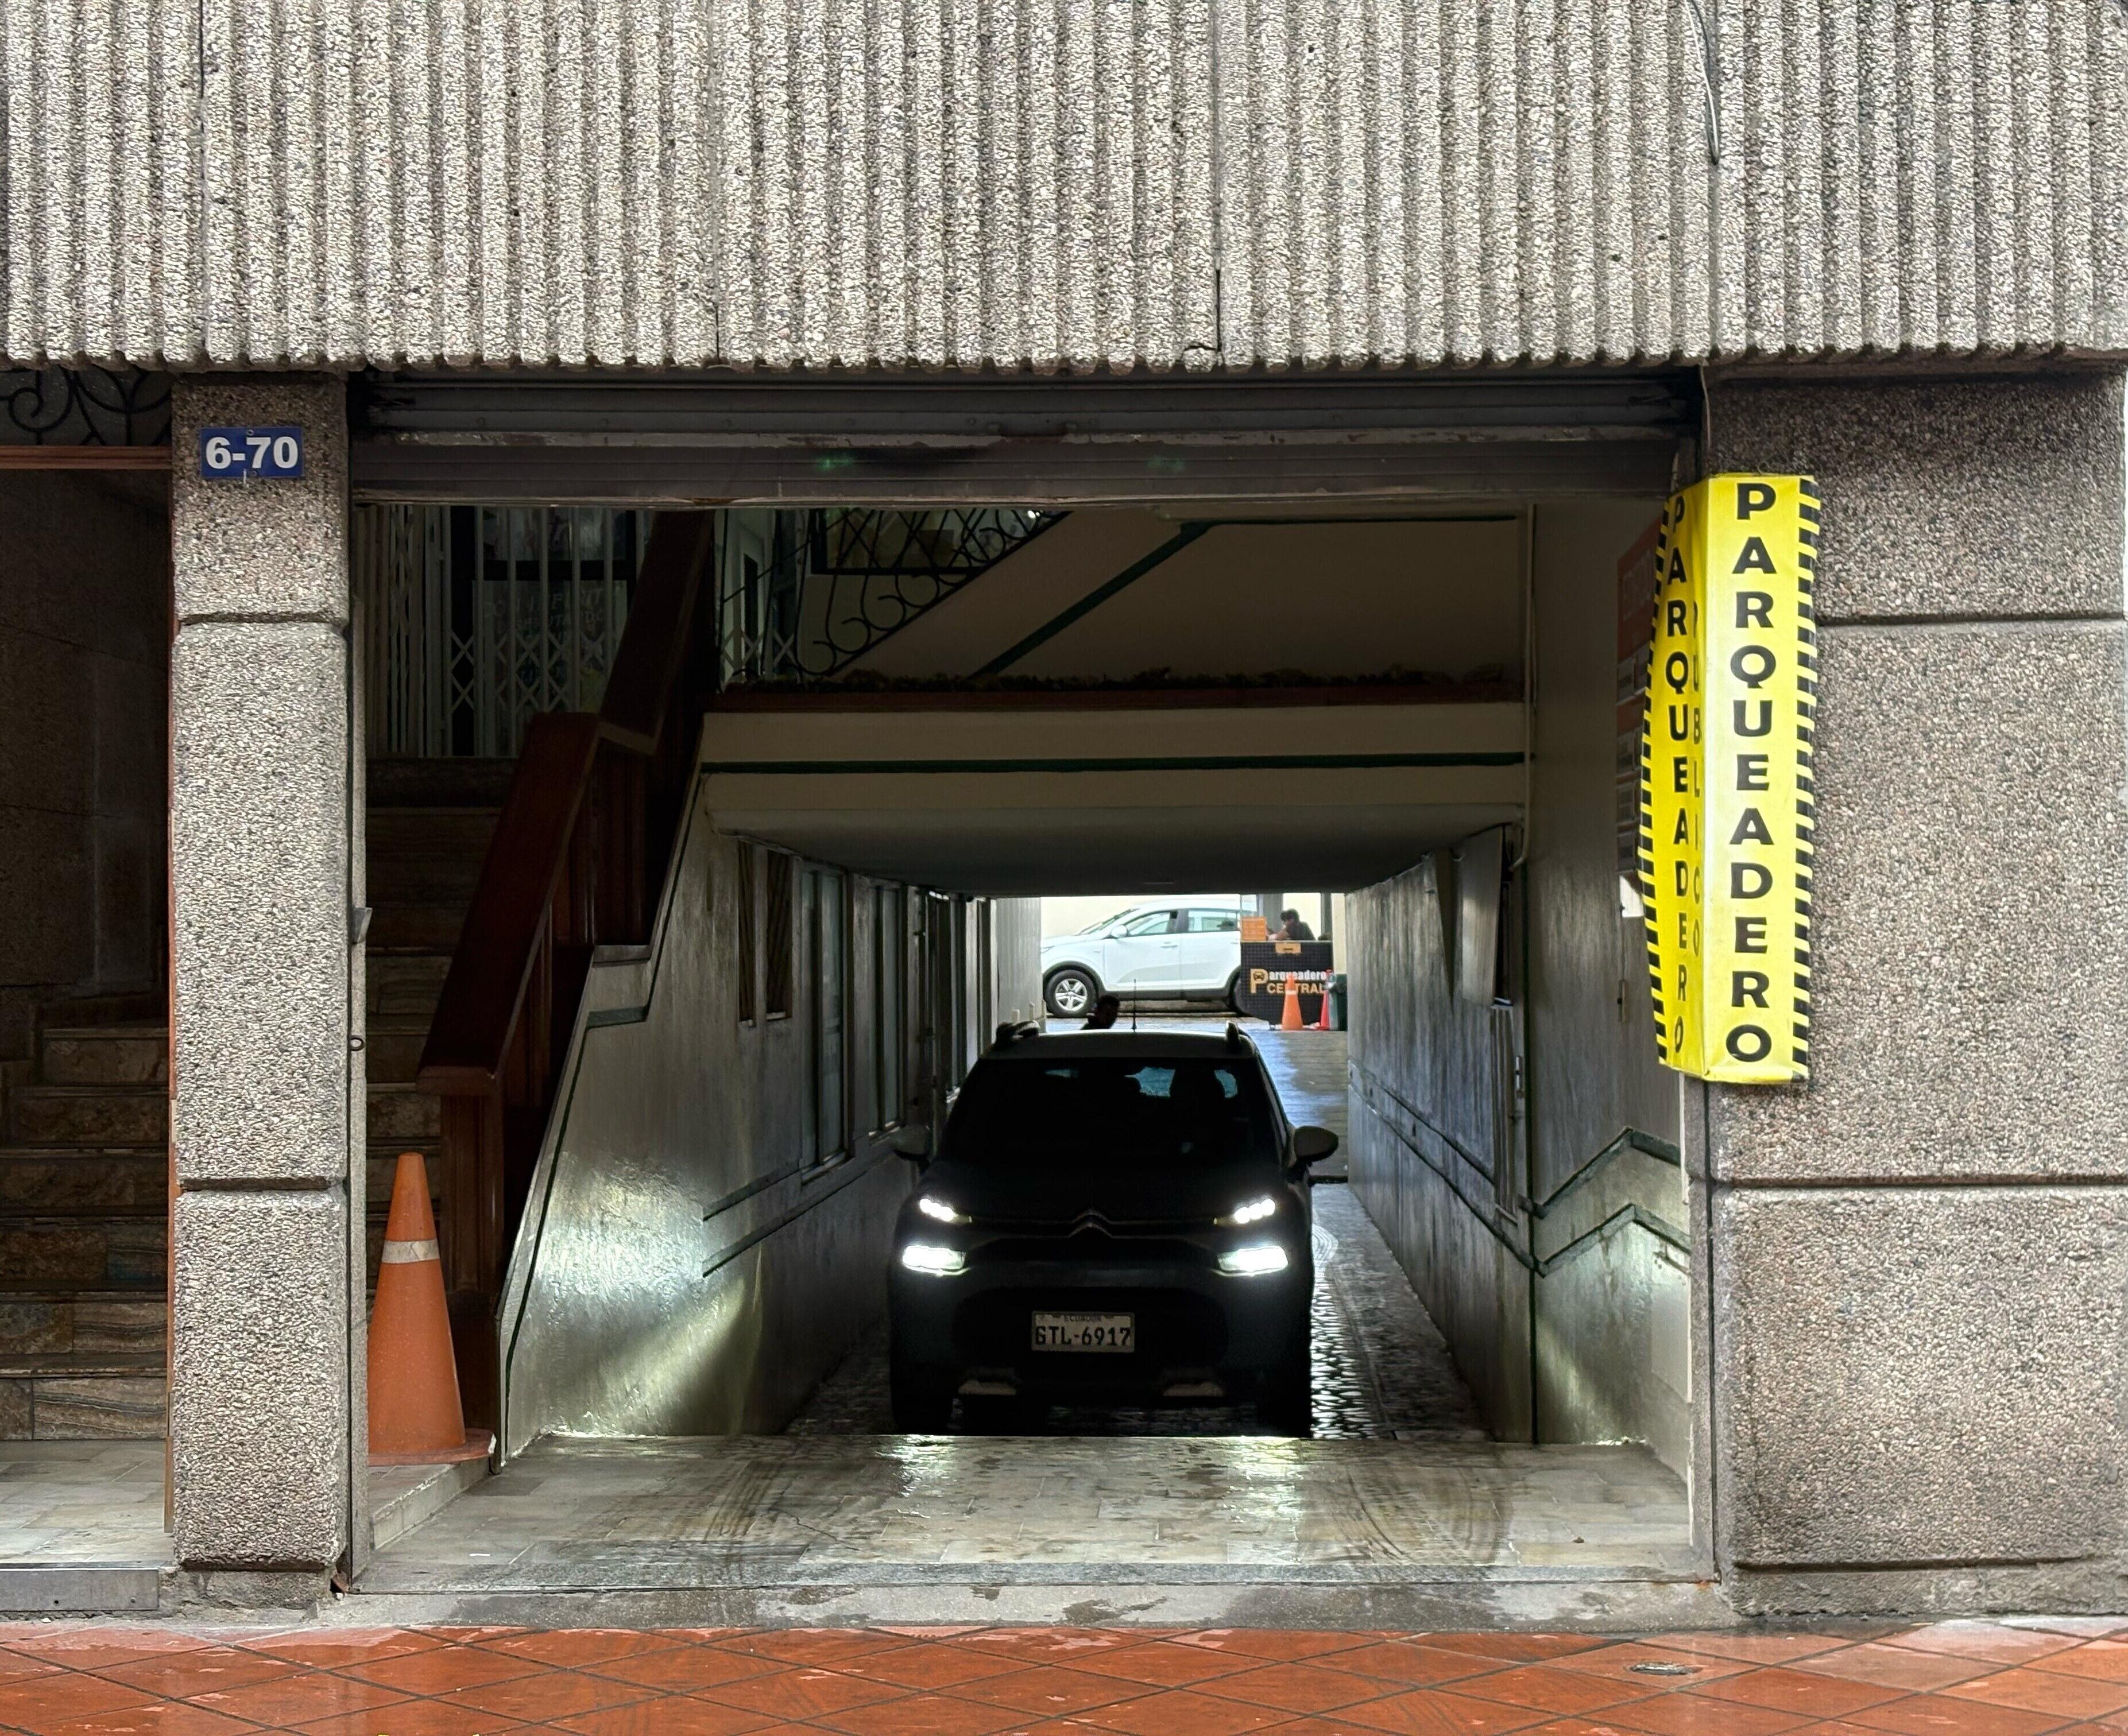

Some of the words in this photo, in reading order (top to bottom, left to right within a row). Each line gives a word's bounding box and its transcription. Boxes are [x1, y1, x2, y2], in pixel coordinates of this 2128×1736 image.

[206, 436, 299, 470] 6-70
[1665, 495, 1689, 1053] PARQUEADERO
[1725, 483, 1777, 1063] PARQUEADERO
[1250, 968, 1327, 994] Parqeadero
[1266, 983, 1325, 994] CETRAL
[1035, 1326, 1131, 1346] GTL-6917
